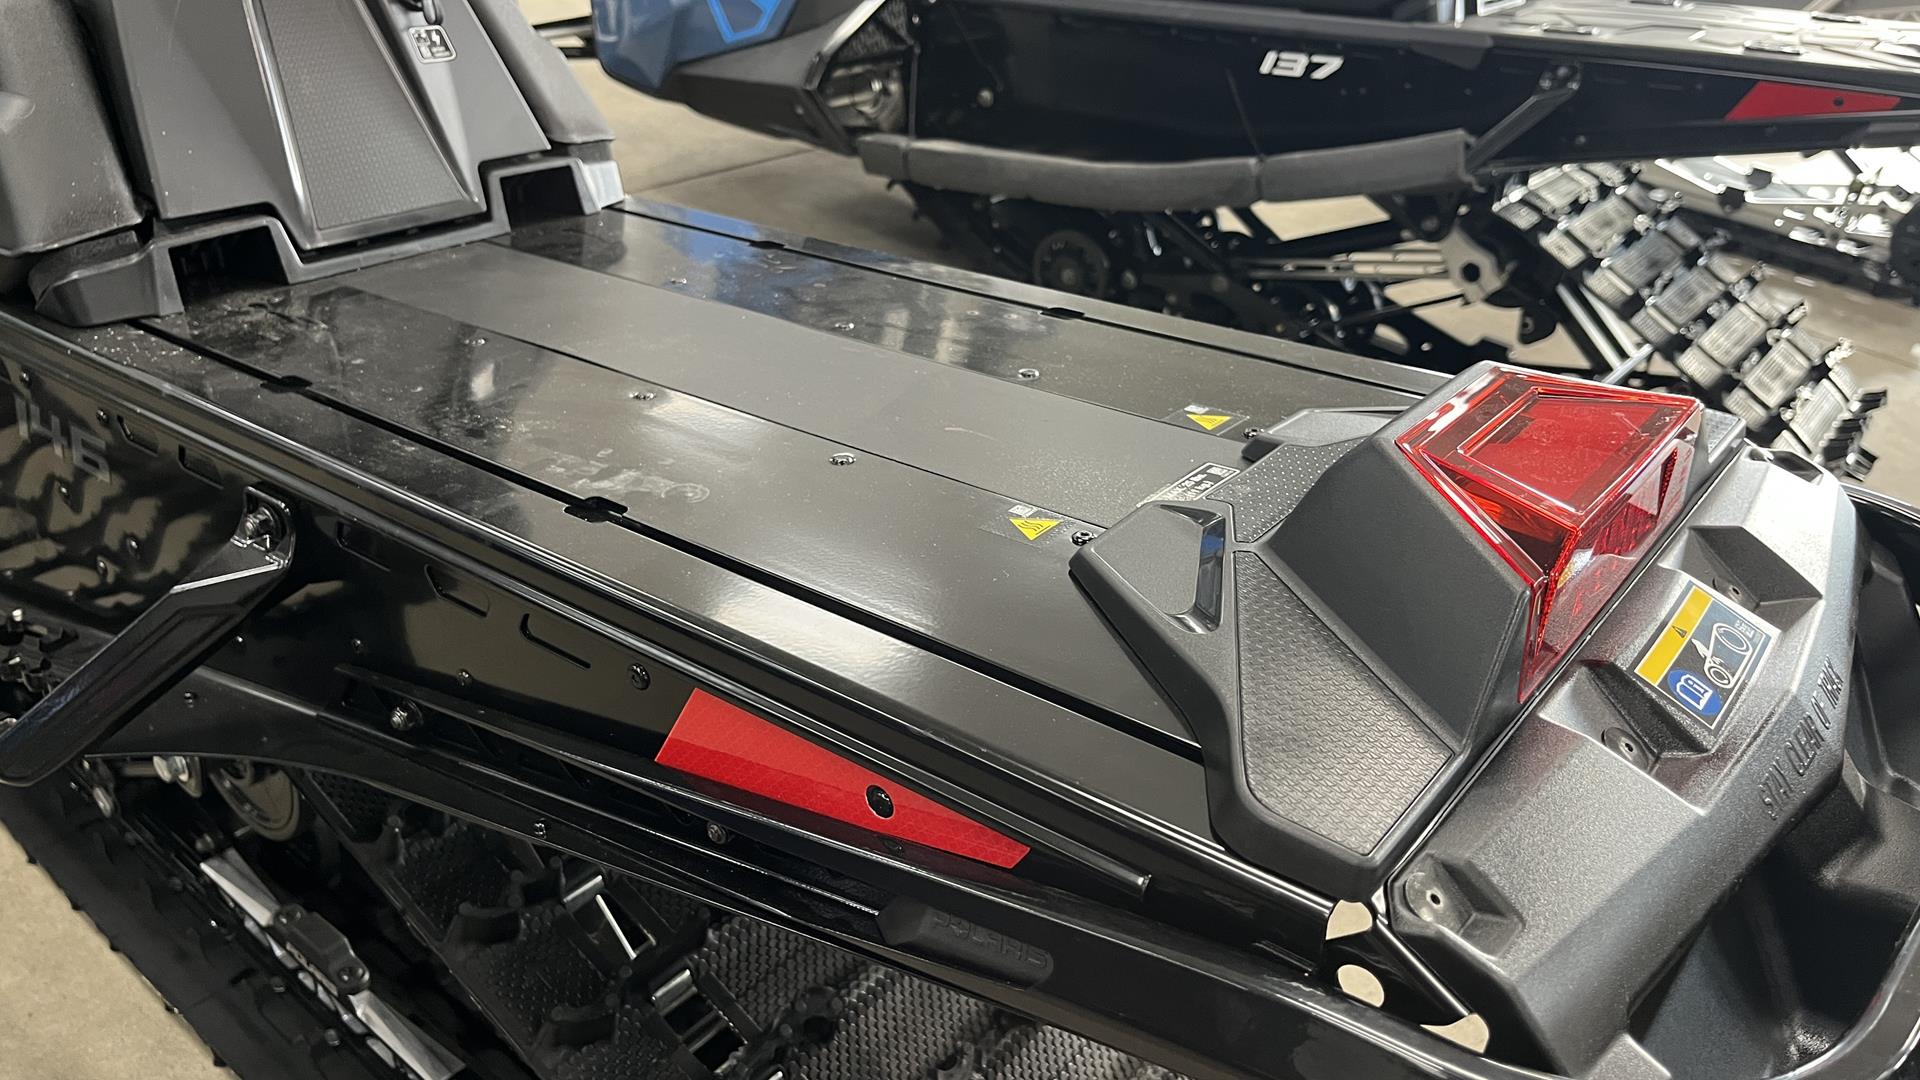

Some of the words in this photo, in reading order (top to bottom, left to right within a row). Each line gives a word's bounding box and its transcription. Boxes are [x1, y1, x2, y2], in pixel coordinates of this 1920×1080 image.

[1258, 50, 1345, 80] 137
[14, 393, 112, 484] 146
[1811, 690, 1831, 730] OF
[1817, 654, 1844, 709] TRACK
[1783, 711, 1825, 776] CLEAR
[1758, 756, 1794, 821] STAY
[932, 911, 1047, 968] POLARIS
